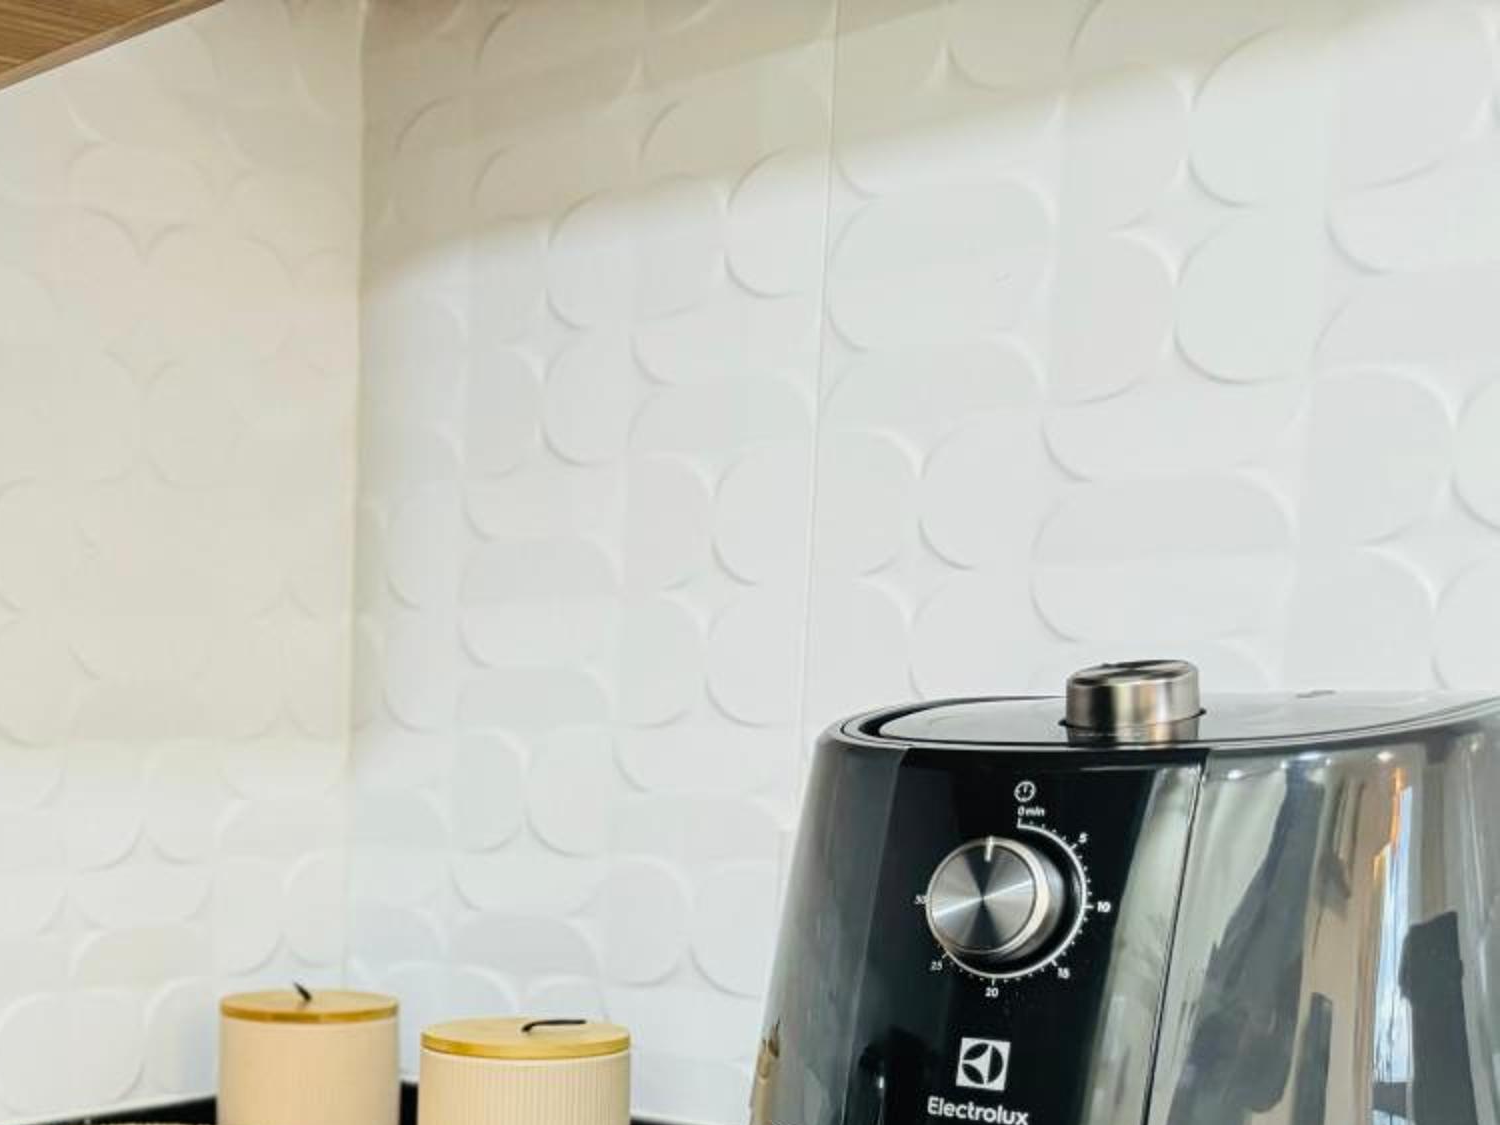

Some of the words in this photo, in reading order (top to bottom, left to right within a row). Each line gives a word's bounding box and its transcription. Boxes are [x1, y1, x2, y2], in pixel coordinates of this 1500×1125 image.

[1078, 832, 1089, 844] 5
[1097, 901, 1112, 913] 10
[930, 960, 943, 971] 25
[1057, 968, 1070, 979] 15
[985, 987, 999, 998] 20
